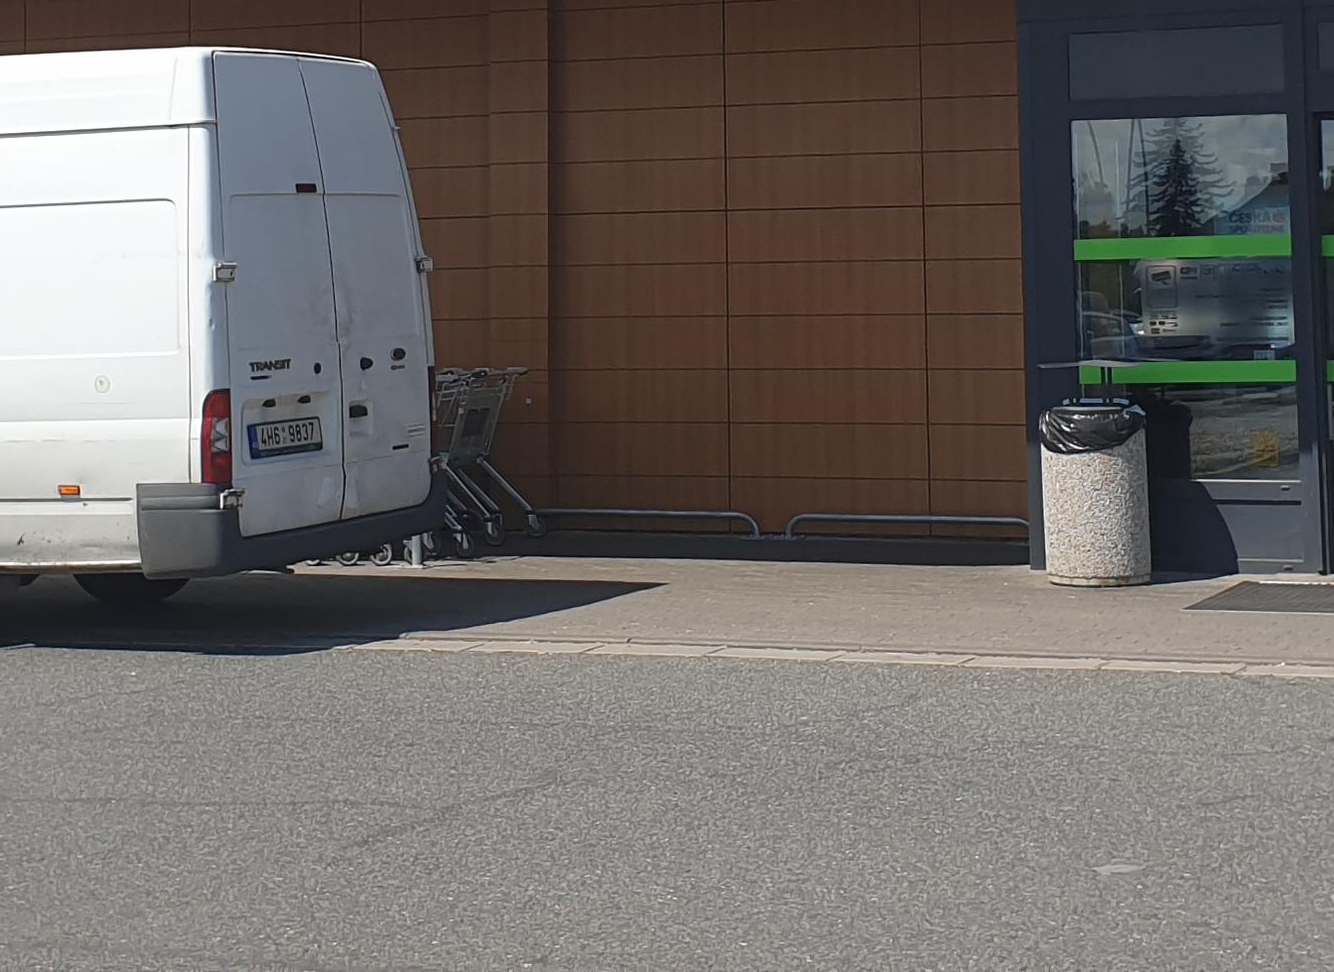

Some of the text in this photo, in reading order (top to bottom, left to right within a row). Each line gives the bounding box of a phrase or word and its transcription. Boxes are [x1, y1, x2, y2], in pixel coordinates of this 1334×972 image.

[249, 359, 291, 373] TRANSIT
[261, 422, 314, 446] 4H6 9837
